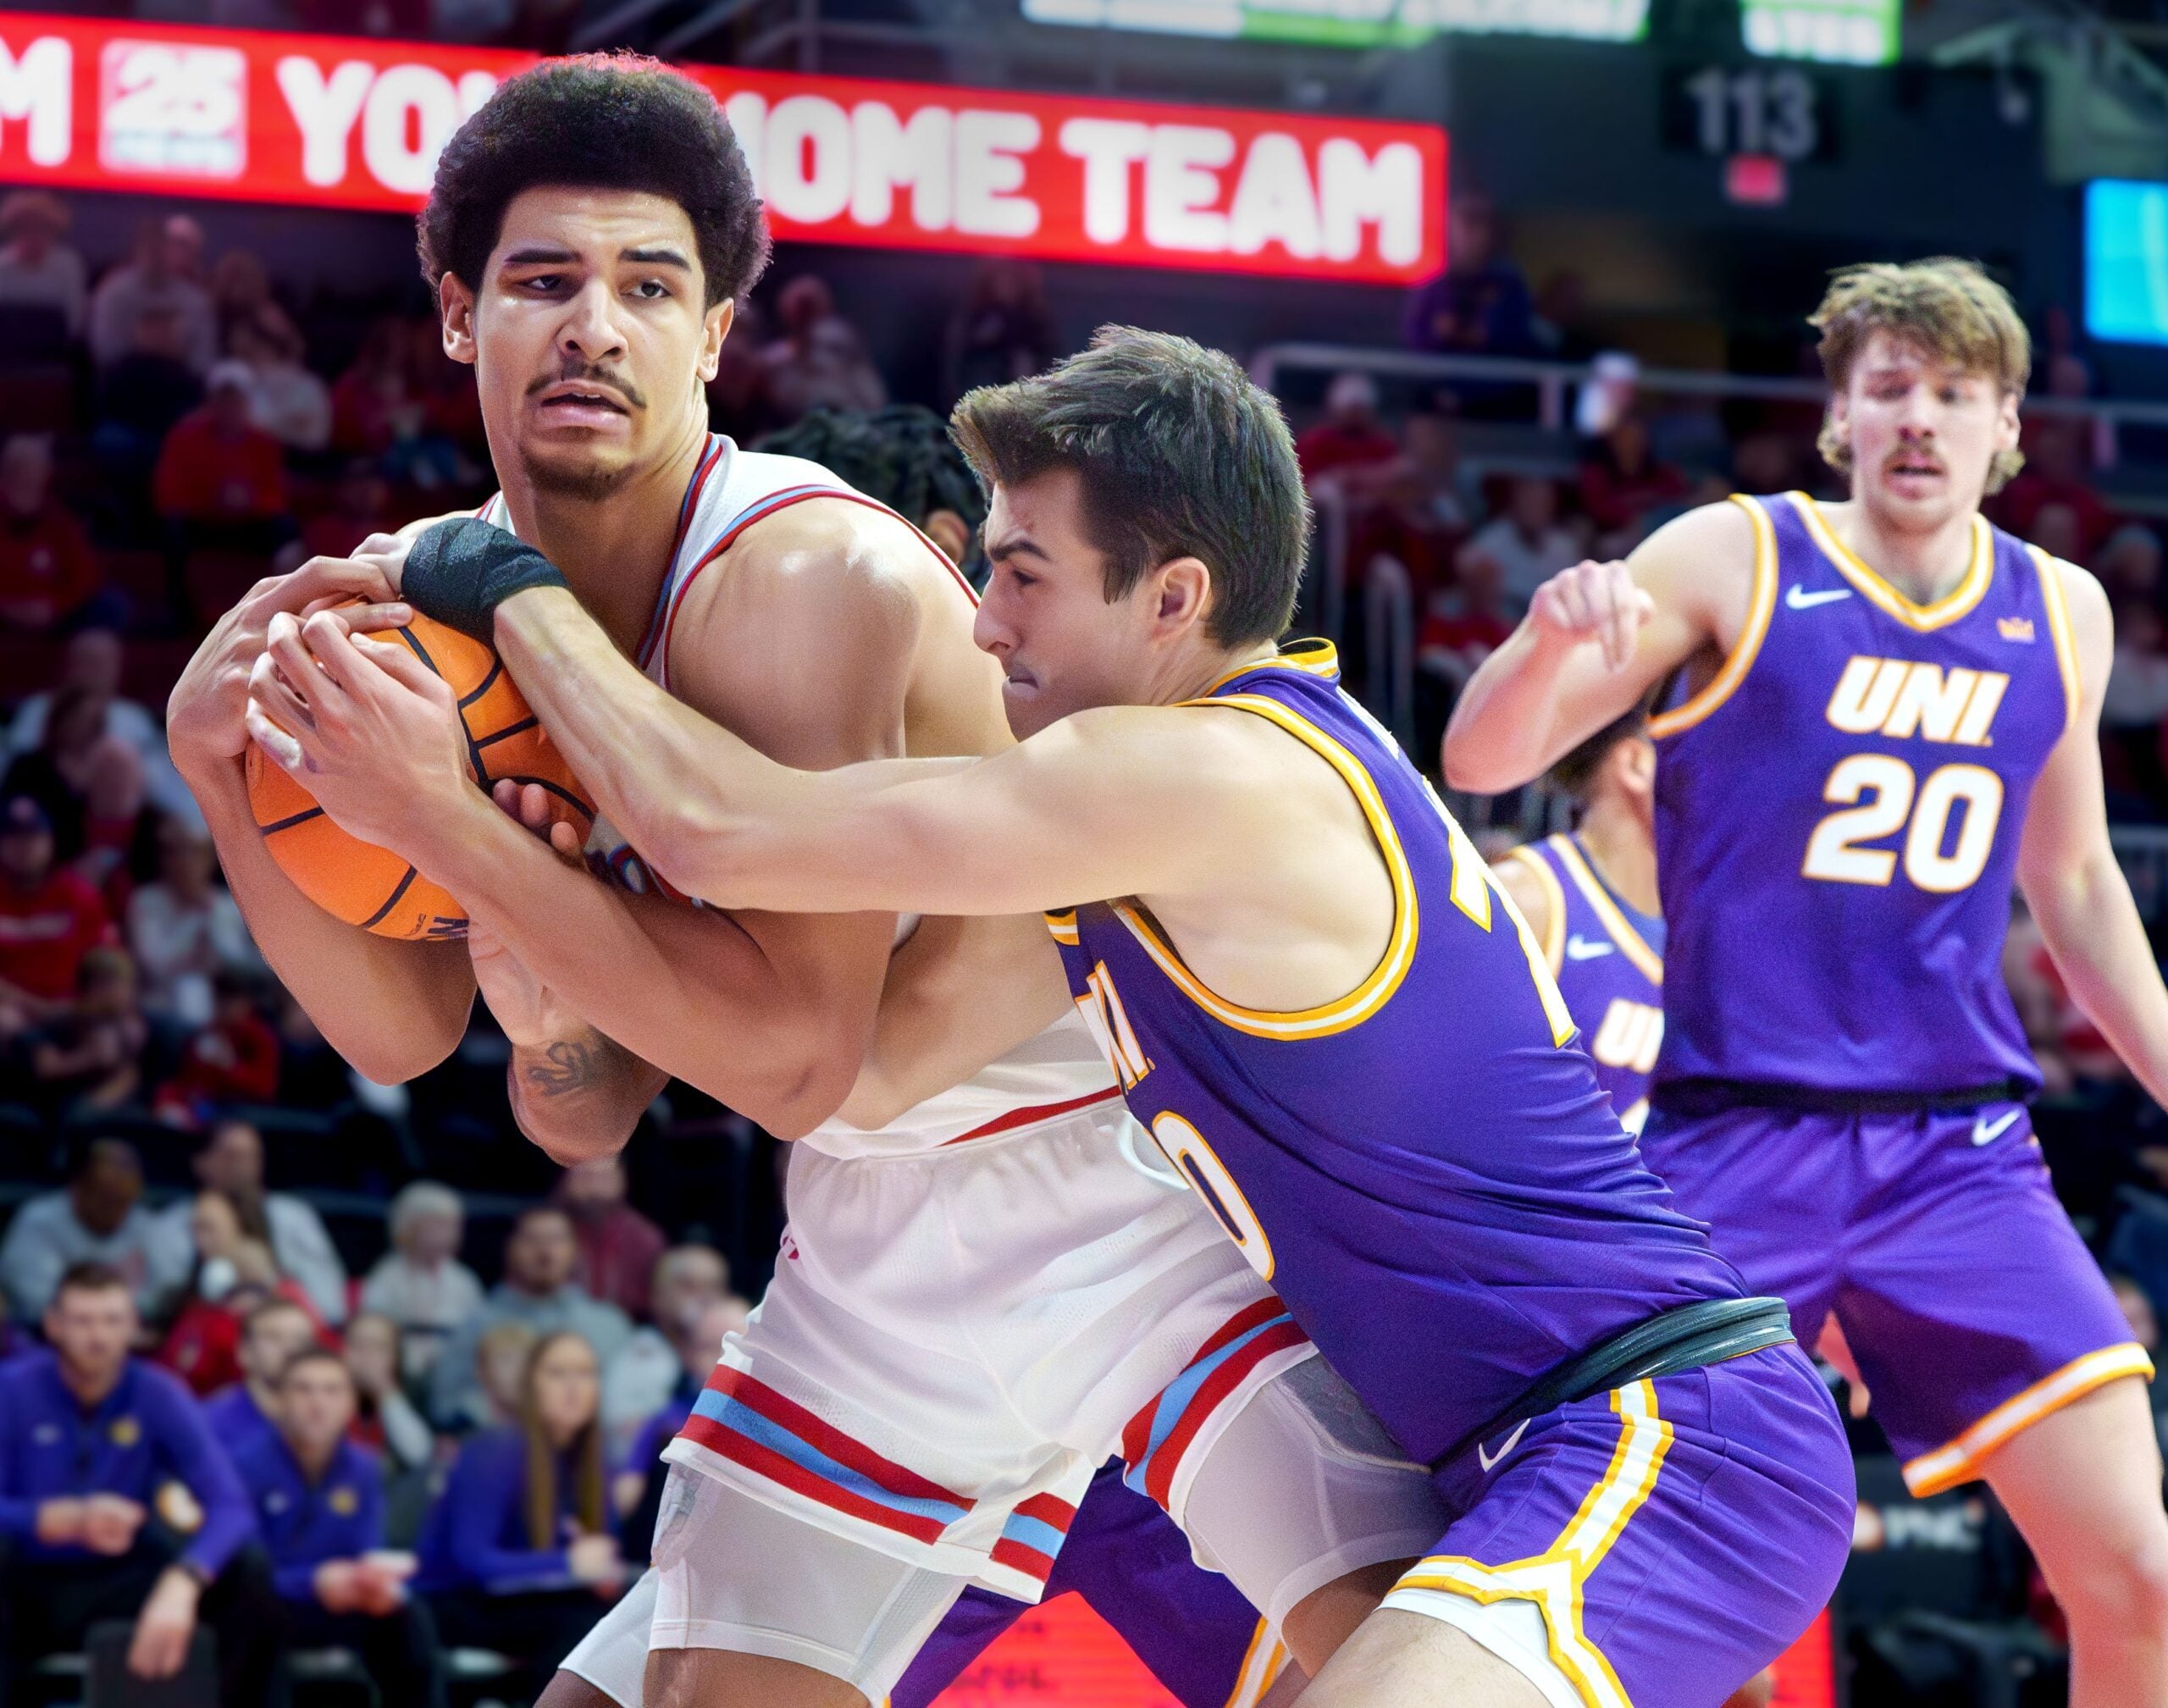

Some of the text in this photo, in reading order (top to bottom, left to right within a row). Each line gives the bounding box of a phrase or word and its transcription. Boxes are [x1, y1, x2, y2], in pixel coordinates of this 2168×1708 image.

[275, 55, 500, 195] YO
[1059, 117, 1424, 267] TEAM
[1684, 67, 1816, 159] 113
[1801, 752, 2005, 894] 20
